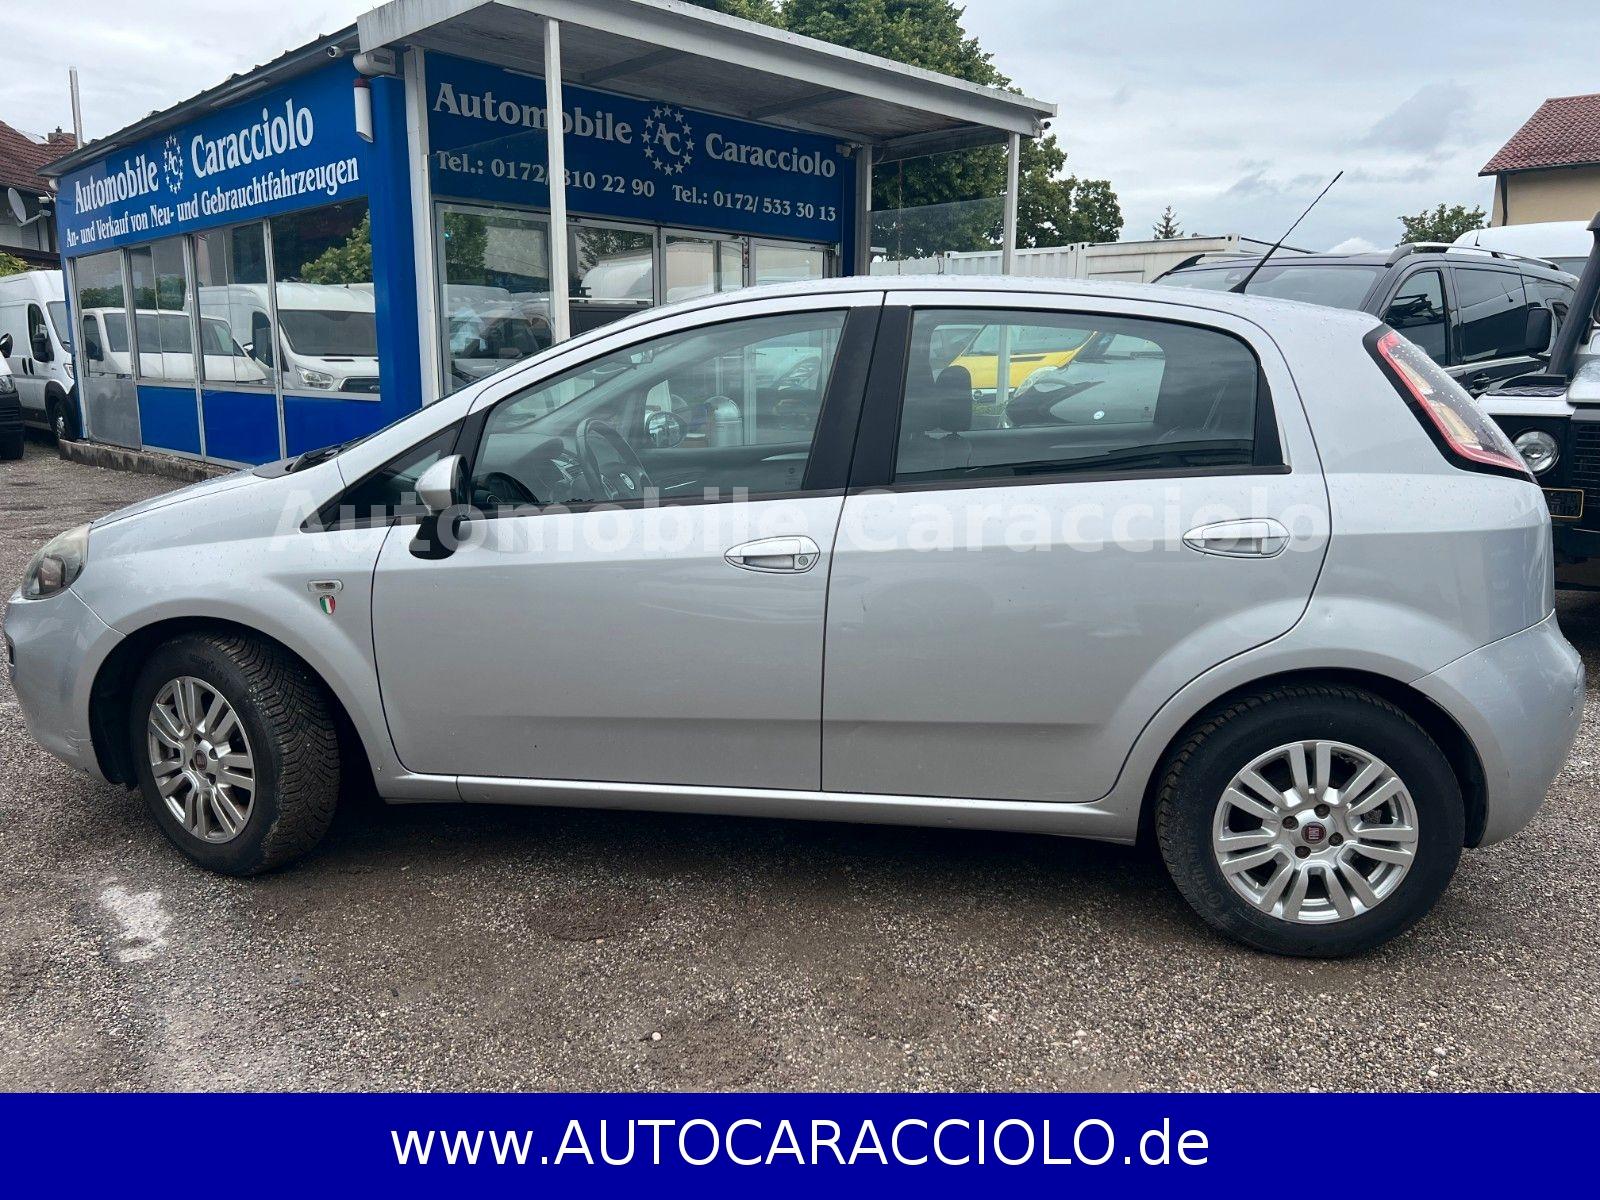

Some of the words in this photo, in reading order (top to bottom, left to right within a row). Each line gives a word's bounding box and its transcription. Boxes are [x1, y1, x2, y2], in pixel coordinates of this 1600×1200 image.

[75, 154, 158, 215] Automobile
[191, 98, 314, 179] Caracciolo
[436, 150, 484, 175] Tel.:
[602, 174, 626, 194] 22
[631, 178, 655, 198] 90
[705, 133, 836, 178] Caracciolo
[67, 228, 79, 248] An-
[80, 221, 96, 244] und
[96, 211, 129, 240] Verkauf
[130, 211, 149, 232] von
[149, 204, 175, 228] Neu-
[176, 192, 199, 221] und
[201, 156, 360, 216] Gebrauchtfahrzeugen
[672, 184, 708, 205] Tel.:
[713, 190, 759, 213] 0172/
[762, 197, 791, 216] 533
[795, 202, 814, 219] 30
[819, 206, 836, 222] 13
